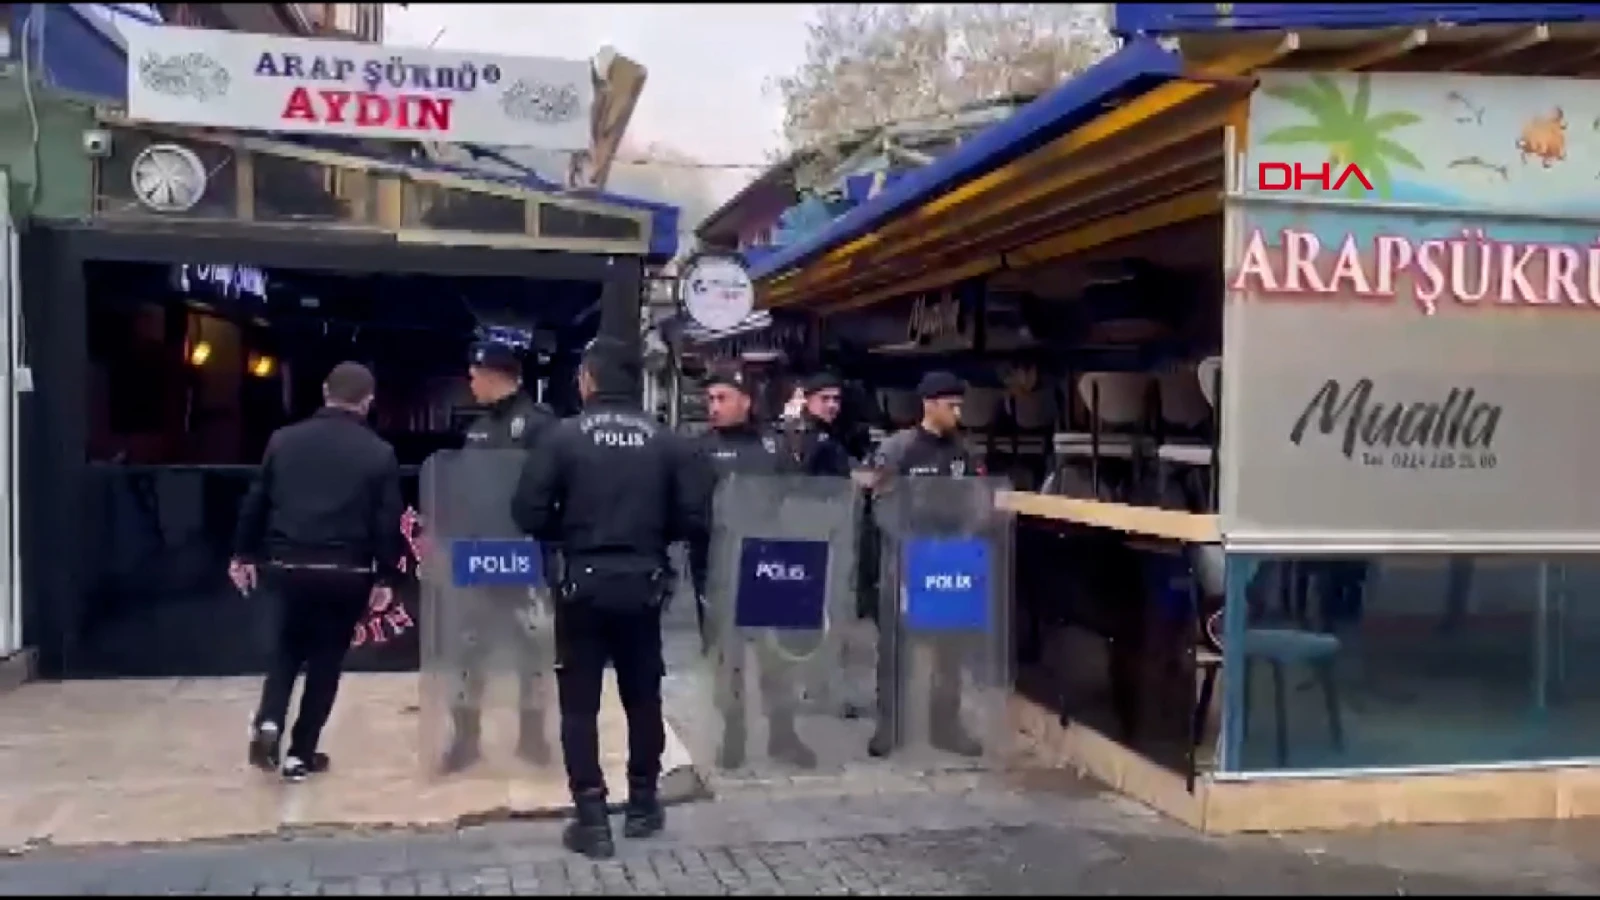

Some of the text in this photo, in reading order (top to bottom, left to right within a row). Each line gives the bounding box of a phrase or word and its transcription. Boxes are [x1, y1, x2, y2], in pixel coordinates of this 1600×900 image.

[254, 51, 355, 81] ARAP
[281, 86, 454, 131] AYDIN
[1289, 378, 1503, 459] Mualla
